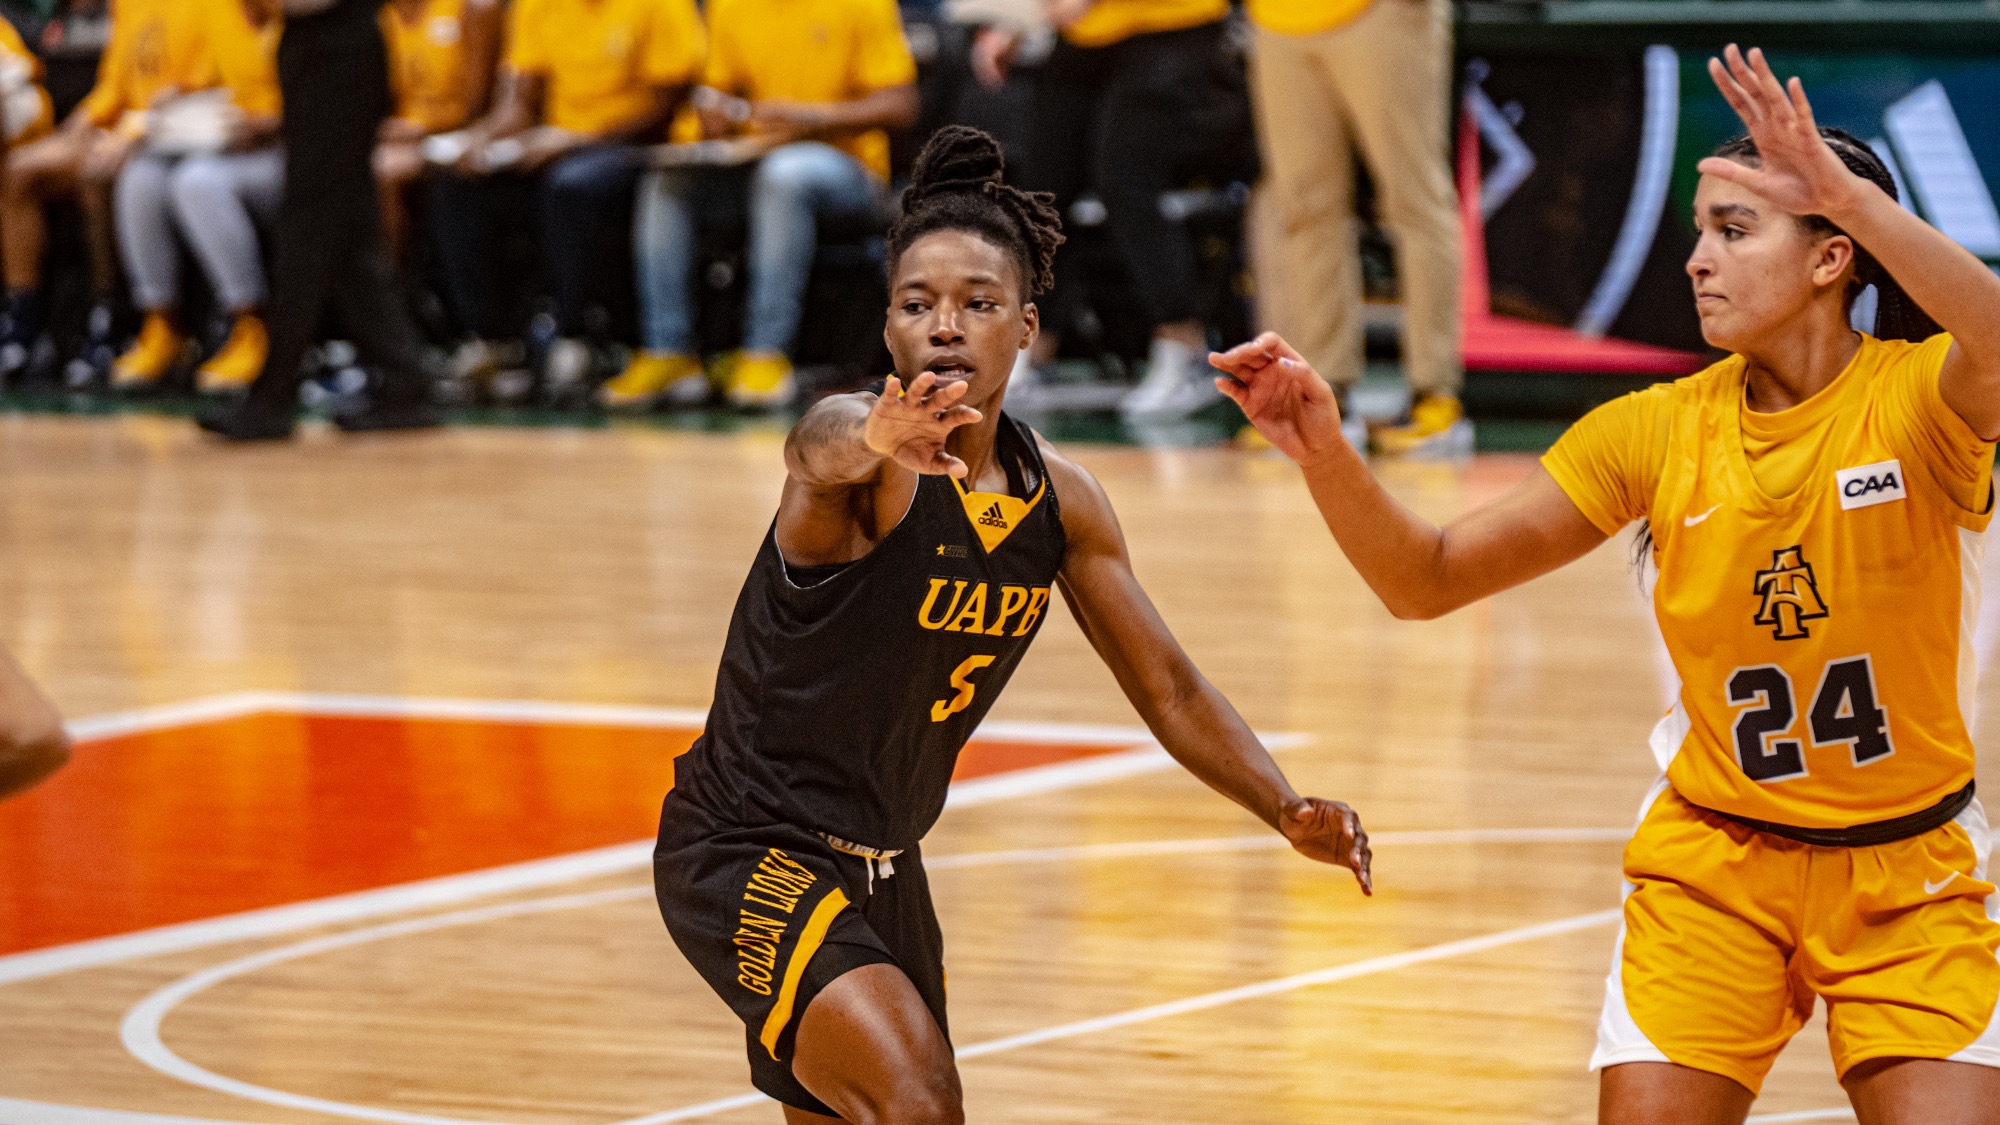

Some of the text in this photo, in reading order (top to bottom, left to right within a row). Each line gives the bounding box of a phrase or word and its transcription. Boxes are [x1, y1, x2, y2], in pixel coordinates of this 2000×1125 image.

[1844, 471, 1900, 498] CAA
[978, 516, 1008, 529] adidas
[918, 576, 1051, 637] UAPB
[930, 654, 997, 723] 5
[1724, 653, 1896, 784] 24
[732, 847, 818, 996] GOLDEN LIONS
